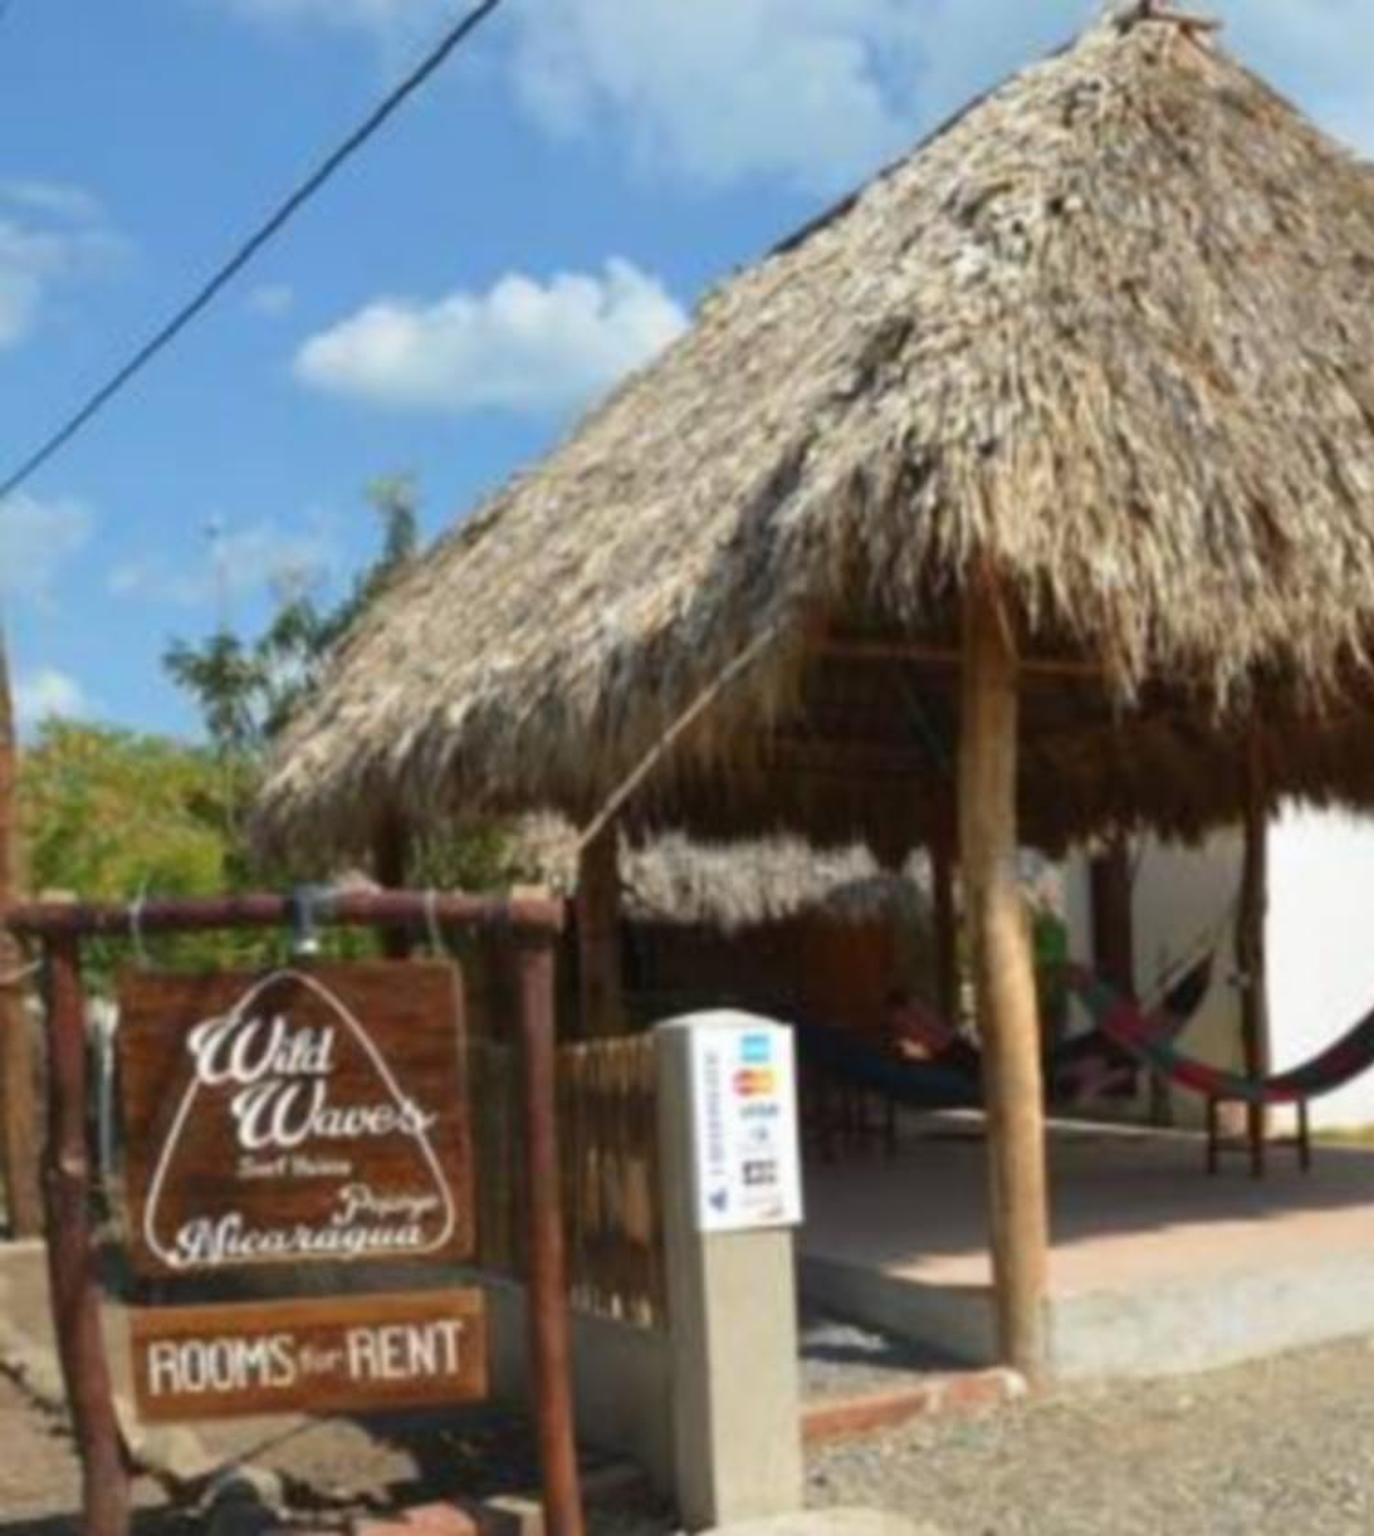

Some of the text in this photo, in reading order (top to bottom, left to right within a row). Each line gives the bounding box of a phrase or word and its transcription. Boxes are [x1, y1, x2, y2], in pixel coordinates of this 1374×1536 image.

[187, 1015, 334, 1084] Wild
[231, 1079, 437, 1148] Waves
[169, 1213, 424, 1267] Nicaragua
[147, 1319, 463, 1395] ROOMS for RENT
